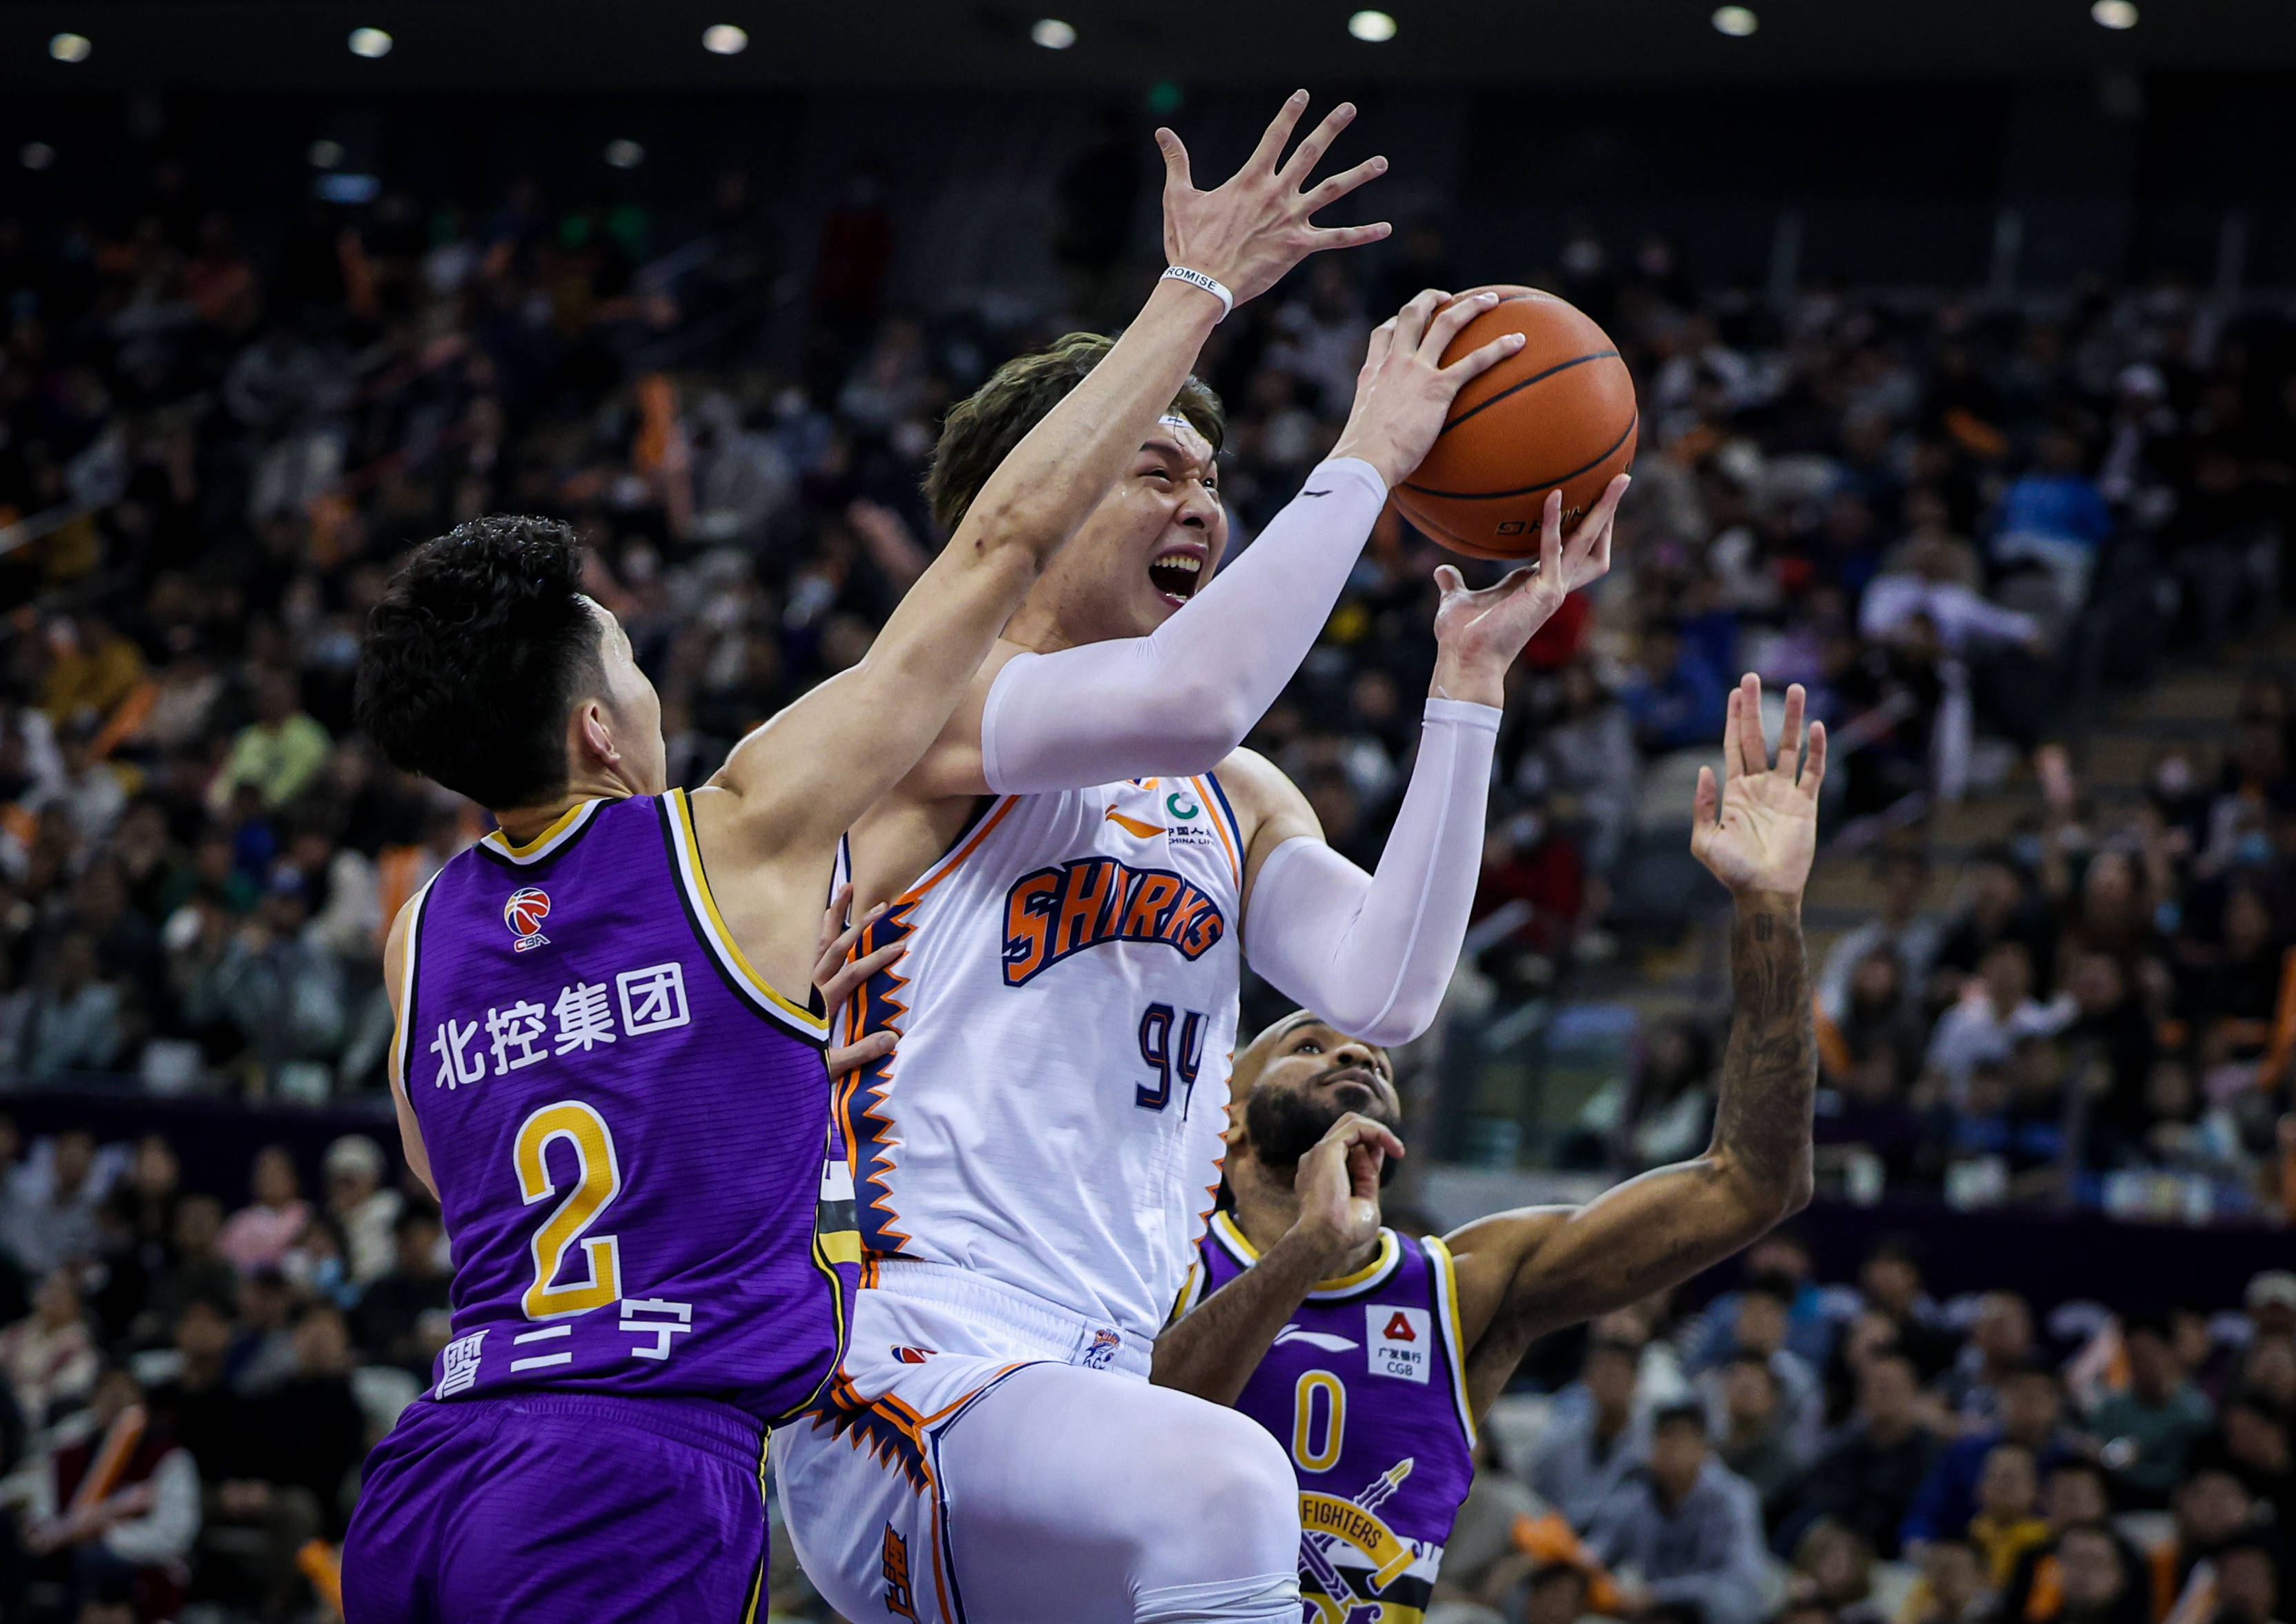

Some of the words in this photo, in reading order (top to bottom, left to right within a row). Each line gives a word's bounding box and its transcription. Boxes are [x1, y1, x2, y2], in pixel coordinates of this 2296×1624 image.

[514, 933, 551, 953] CBA
[430, 962, 690, 1090] 北控集团
[1135, 1000, 1210, 1122] 94
[513, 1100, 622, 1322] 2
[1386, 1361, 1412, 1376] CGB
[1292, 1369, 1346, 1473] 0
[1303, 1499, 1382, 1549] FIGHTERS
